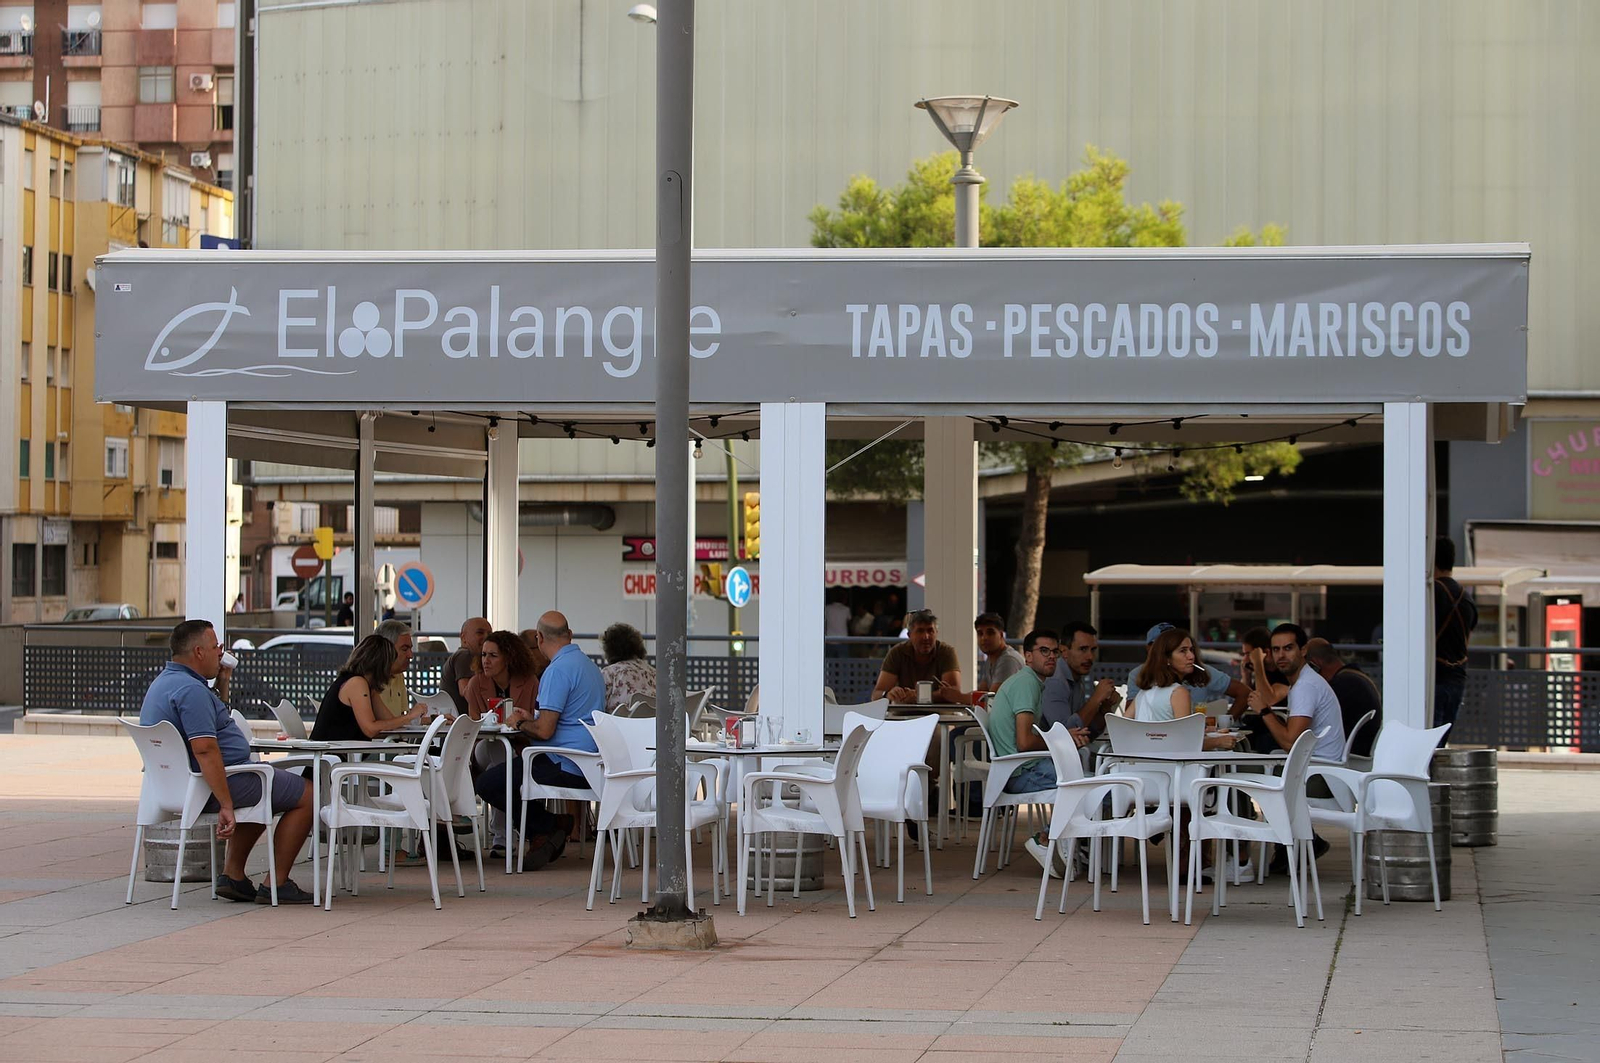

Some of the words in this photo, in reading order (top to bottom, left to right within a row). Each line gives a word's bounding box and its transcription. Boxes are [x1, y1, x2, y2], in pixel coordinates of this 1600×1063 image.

[276, 285, 336, 359] El
[395, 285, 722, 378] Palange
[846, 302, 974, 359] TAPAS
[1003, 301, 1219, 359] PESCADOS
[1249, 299, 1471, 358] MARISCOS
[624, 573, 657, 596] CHUR
[825, 568, 902, 585] URROS
